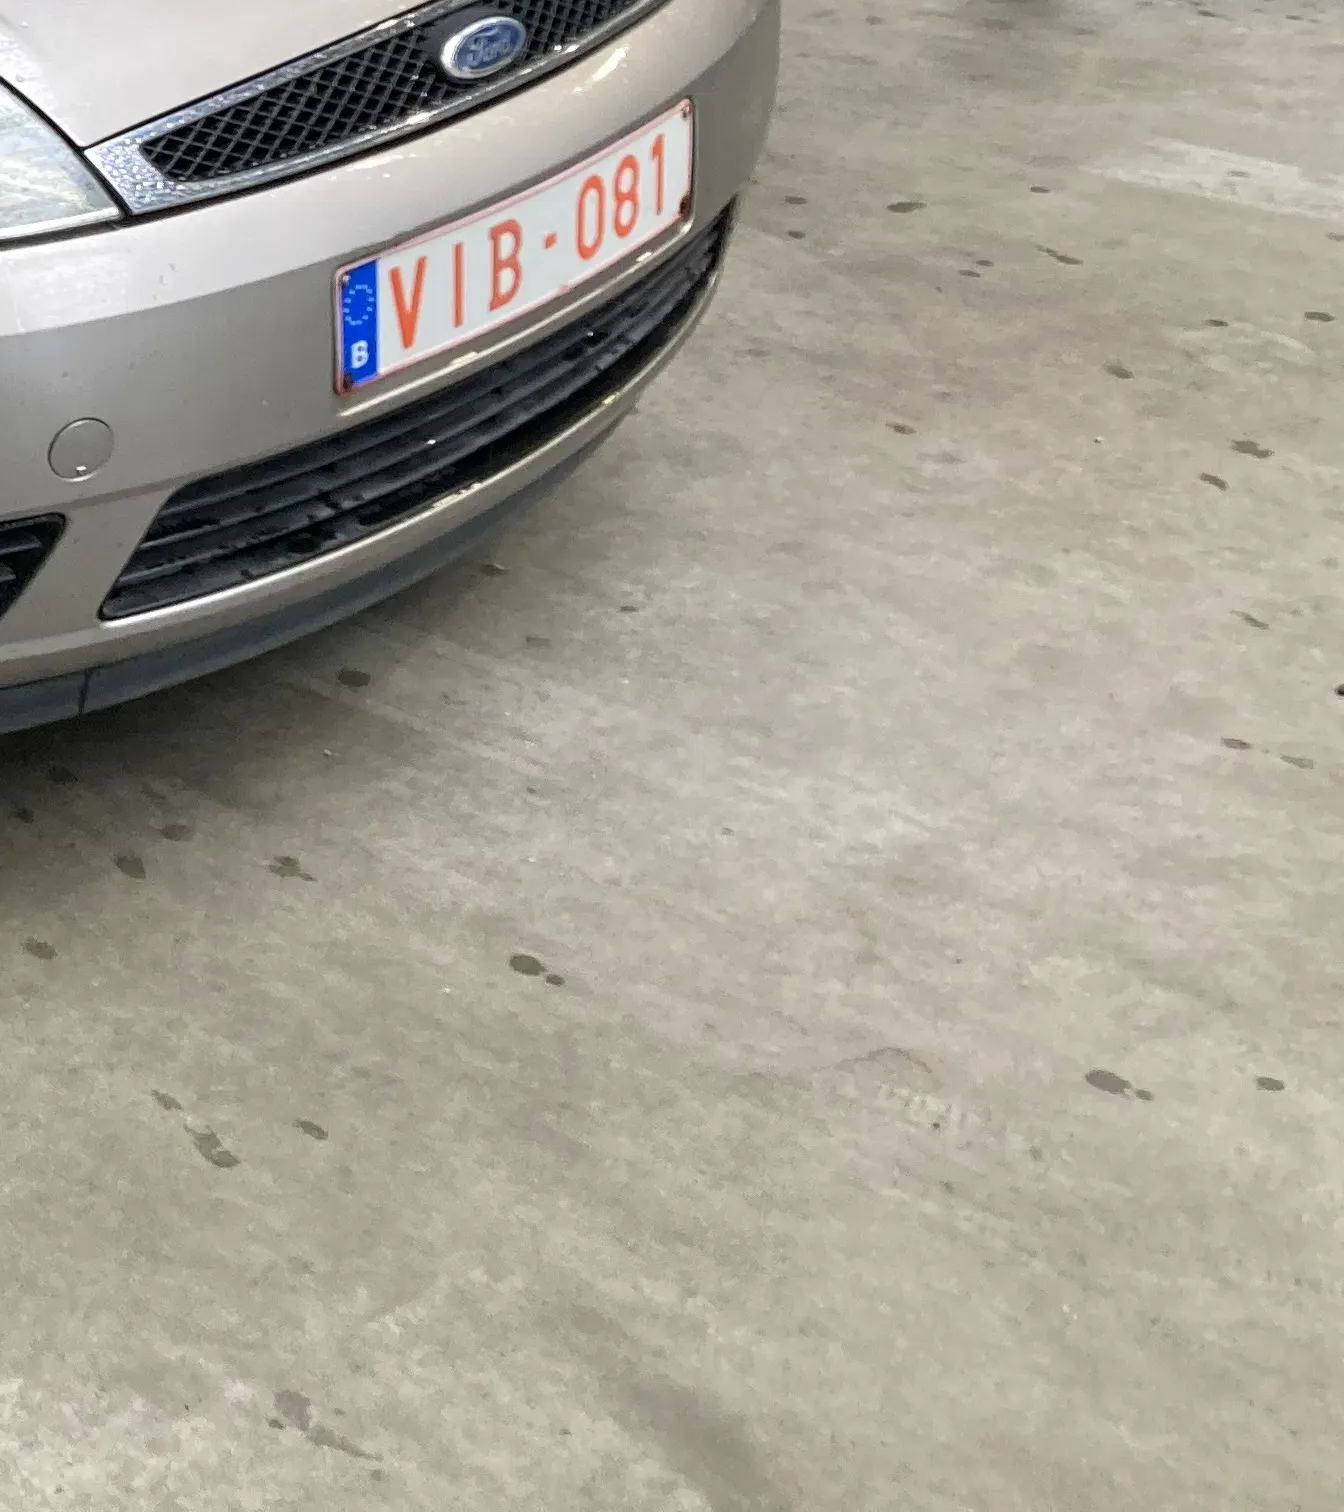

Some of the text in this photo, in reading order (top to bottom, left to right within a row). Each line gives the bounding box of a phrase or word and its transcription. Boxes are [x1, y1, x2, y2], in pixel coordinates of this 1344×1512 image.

[466, 27, 513, 67] Ford
[350, 133, 666, 369] B VIB-081
